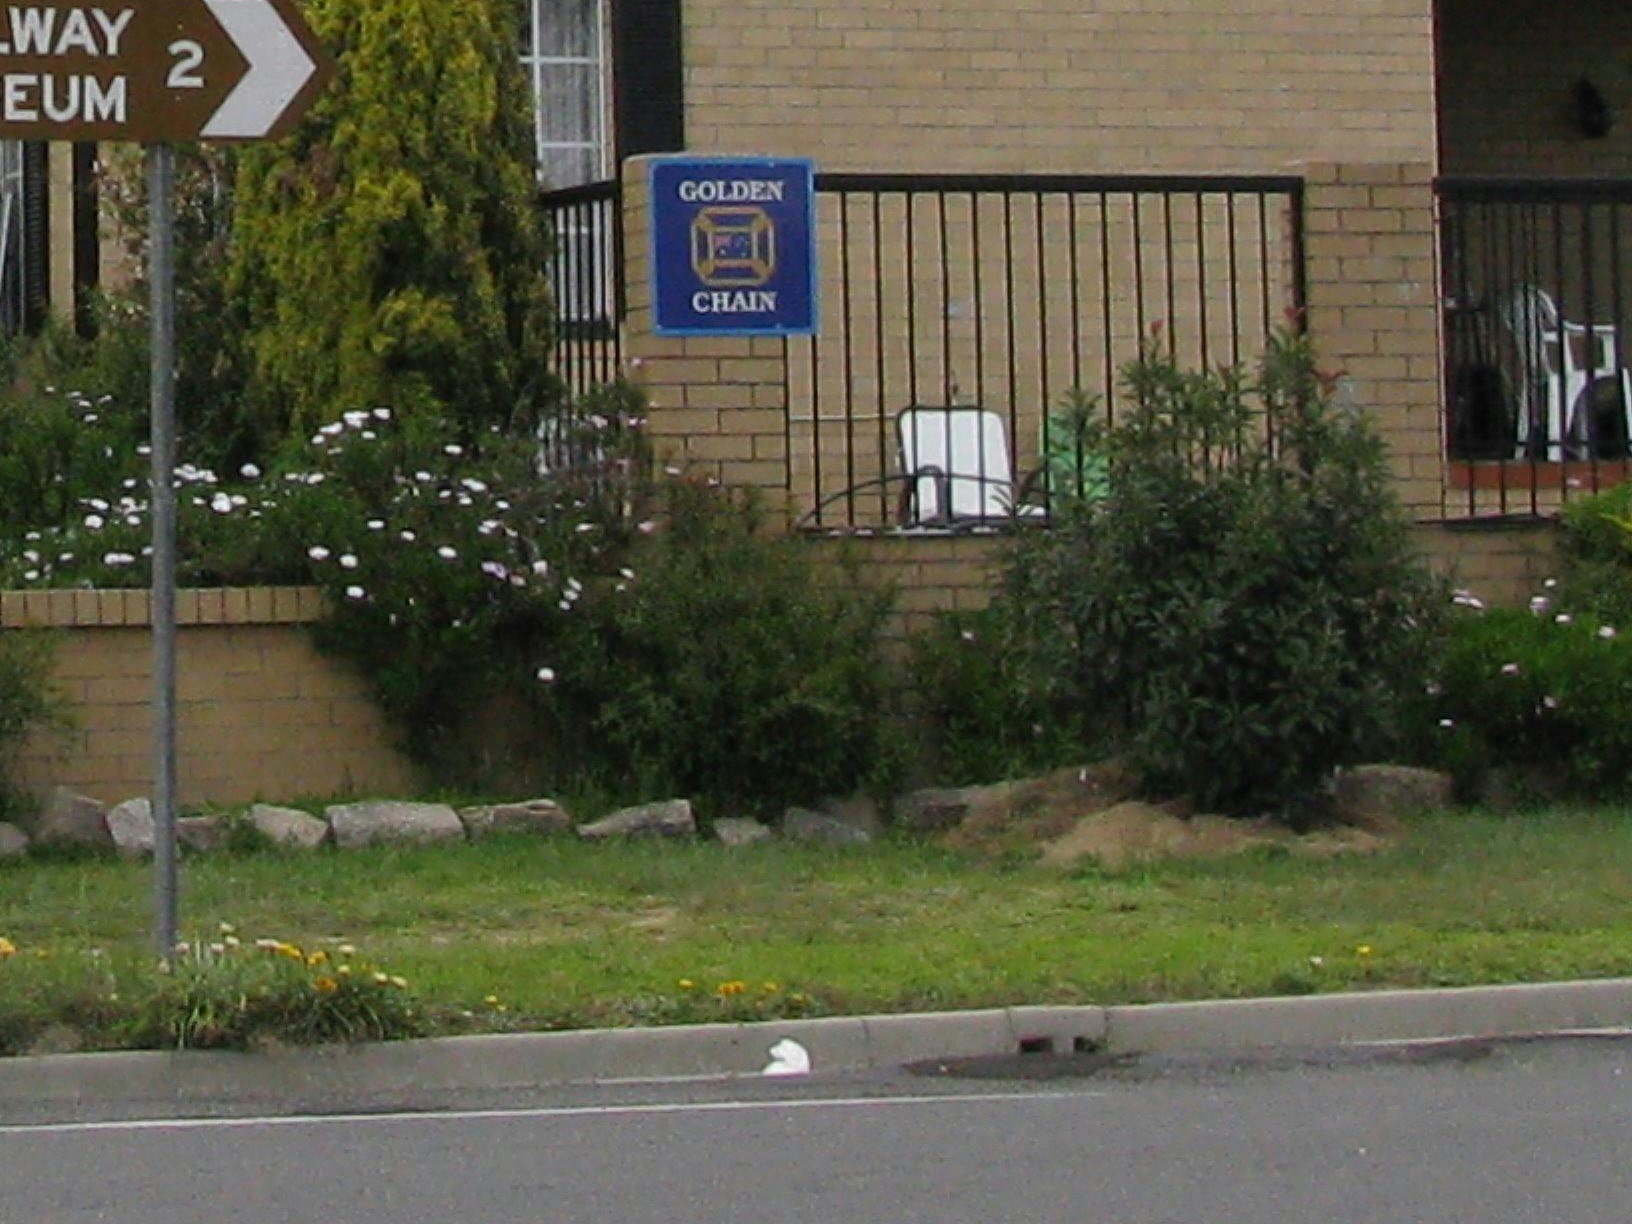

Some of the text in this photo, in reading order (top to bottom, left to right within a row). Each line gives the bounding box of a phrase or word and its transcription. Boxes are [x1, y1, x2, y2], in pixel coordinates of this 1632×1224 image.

[167, 40, 204, 88] 2
[679, 180, 784, 202] GOLDEN
[692, 291, 778, 313] CHAIN
